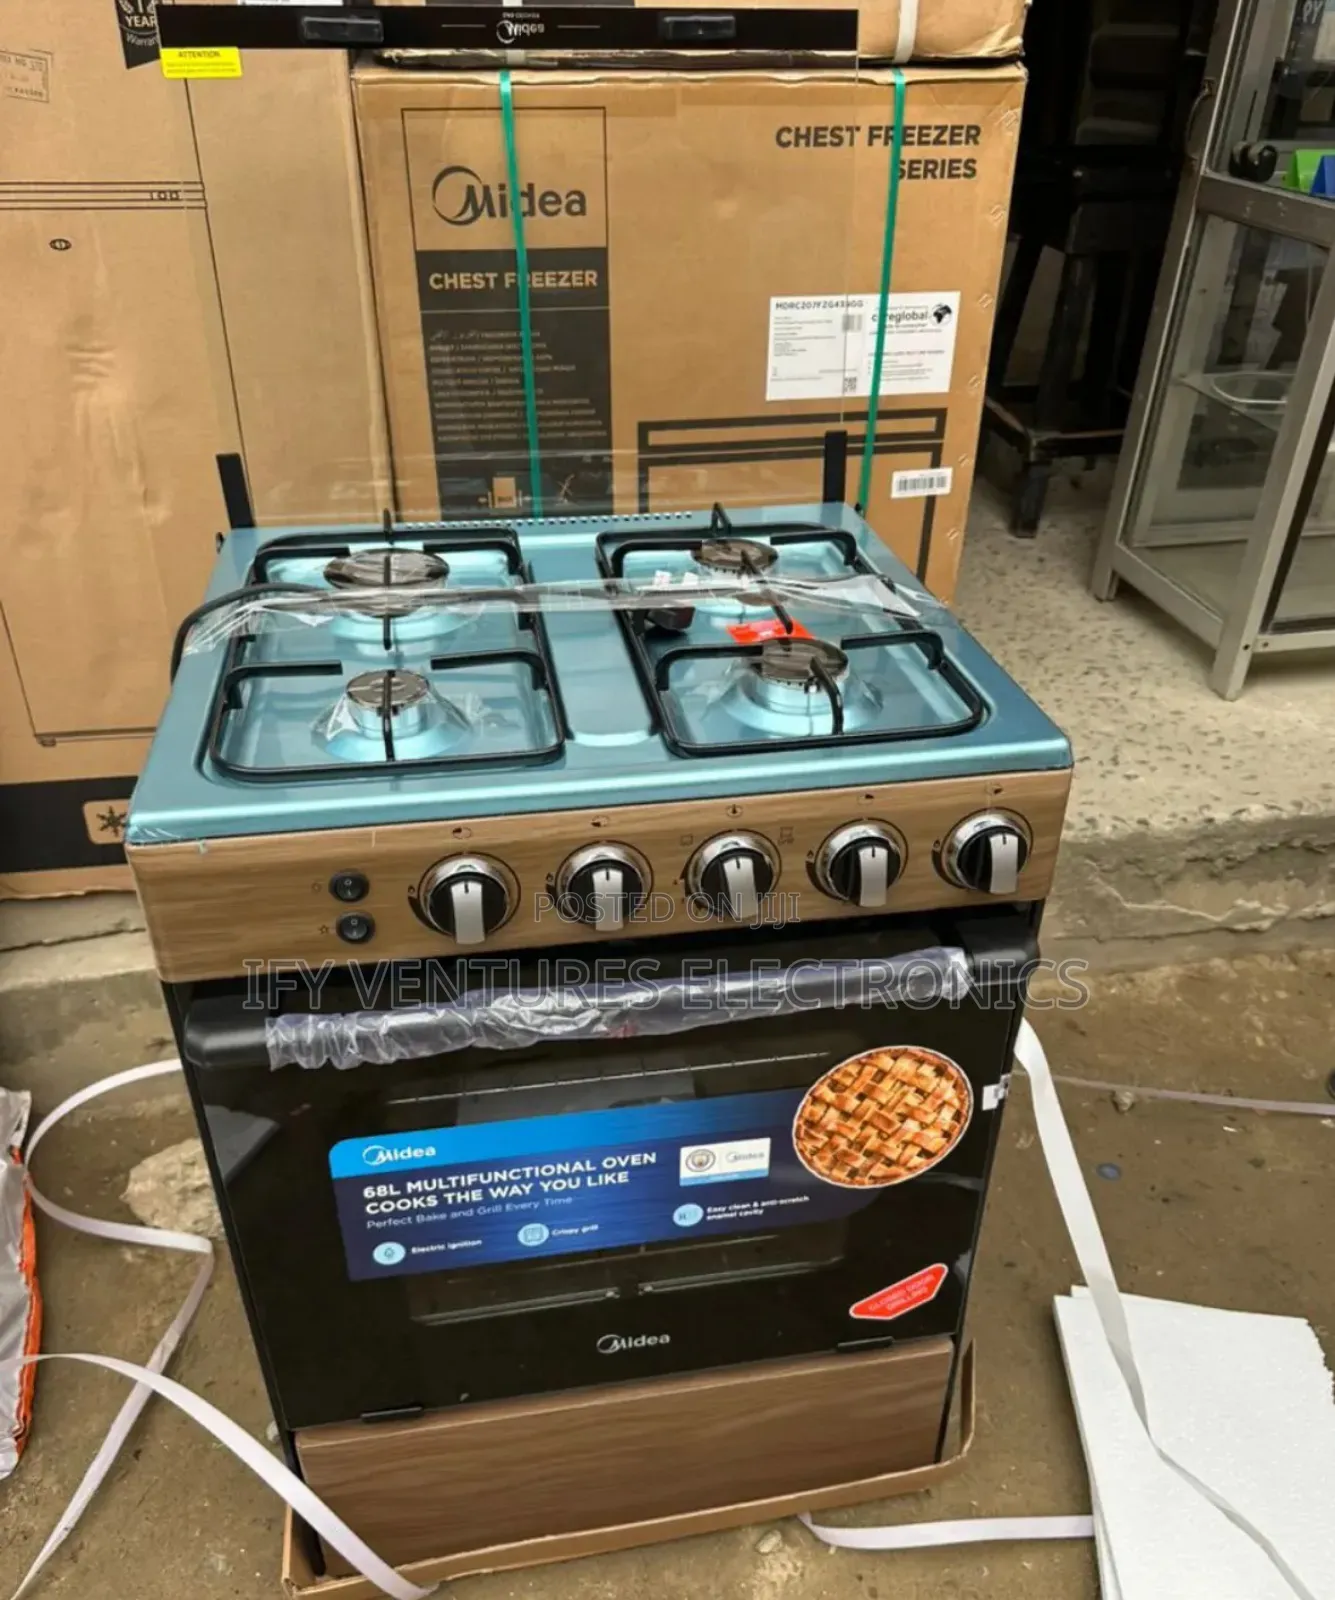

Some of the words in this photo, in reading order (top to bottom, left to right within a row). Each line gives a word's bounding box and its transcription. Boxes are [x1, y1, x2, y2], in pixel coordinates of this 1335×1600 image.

[775, 126, 860, 148] CHEST
[432, 165, 587, 226] Midea
[429, 273, 498, 290] CHEST
[504, 270, 598, 288] FEEZER
[362, 1145, 436, 1166] Midea
[363, 1184, 401, 1200] 68L
[406, 1161, 597, 1193] MULTIFUNCTIONAL
[602, 1152, 657, 1168] OVEN
[366, 1195, 438, 1215] COOKS
[444, 1189, 484, 1205] THE
[489, 1183, 534, 1199] WAY
[540, 1177, 582, 1193] YOU
[587, 1171, 629, 1187] LIKE
[366, 1215, 413, 1229] Perfect
[416, 1211, 447, 1224] Bake
[450, 1207, 474, 1219] and
[477, 1203, 503, 1217] Grill
[505, 1200, 540, 1214] Every
[543, 1195, 573, 1207] Time
[411, 1243, 446, 1254] Electric
[596, 1334, 670, 1354] Midea
